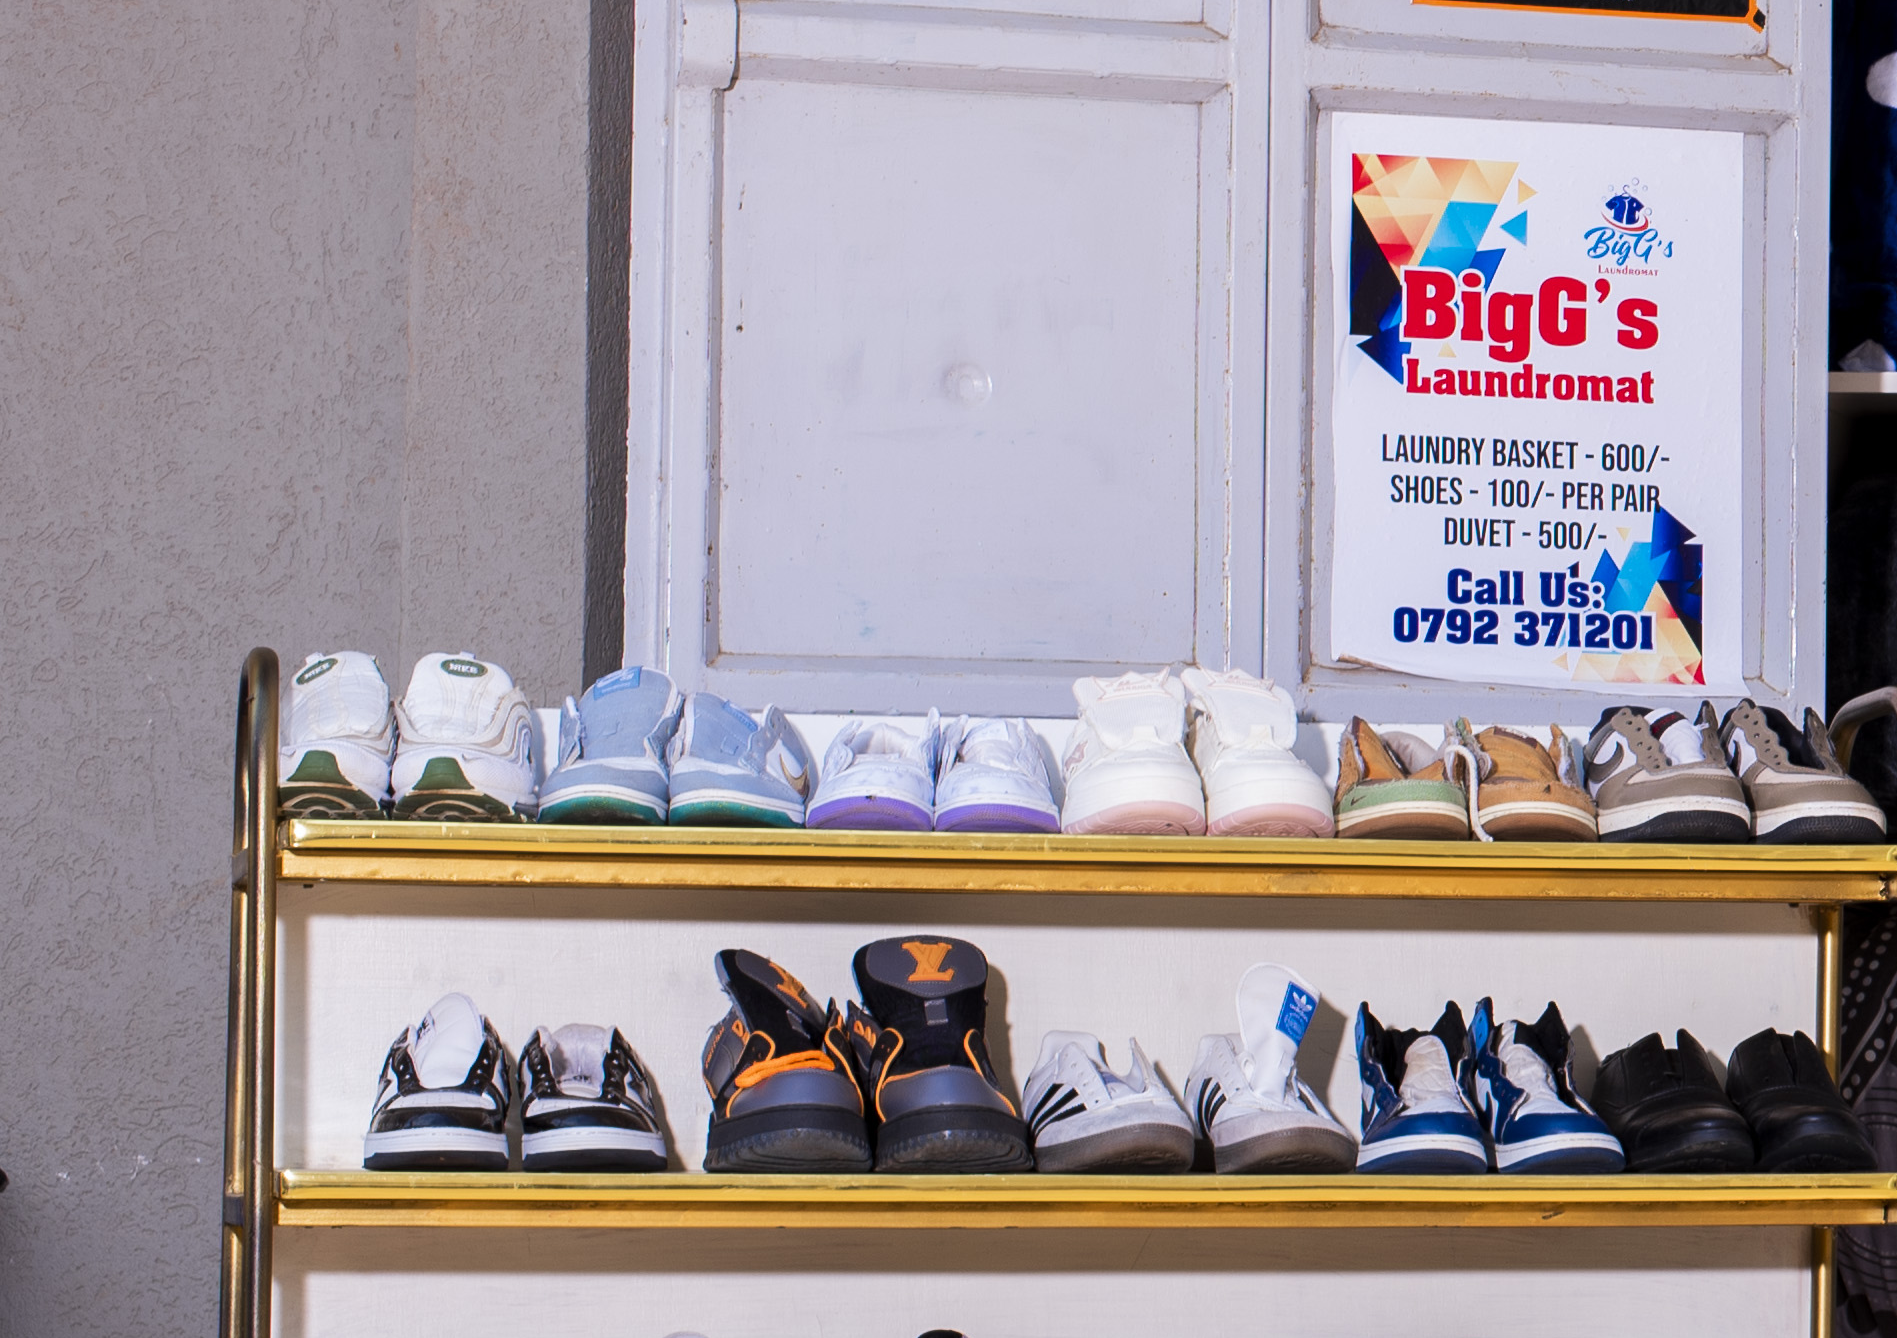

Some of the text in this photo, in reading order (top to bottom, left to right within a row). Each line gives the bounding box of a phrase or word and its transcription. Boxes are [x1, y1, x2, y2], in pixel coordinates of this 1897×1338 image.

[1584, 226, 1674, 266] BigG's
[1403, 269, 1660, 363] BigG's
[1404, 357, 1655, 405] Laundromat
[1381, 434, 1485, 465] LAUNDRY
[1492, 438, 1579, 470] BASKET
[1600, 442, 1671, 474] 600/-
[1389, 475, 1463, 506] SHOES
[1487, 478, 1556, 510] 100/-
[1562, 481, 1604, 512] PER
[1610, 483, 1662, 514] PAIR
[1443, 517, 1516, 549] DUVET
[1537, 520, 1608, 552] 500/-
[1447, 568, 1602, 610] Call Us:
[1392, 607, 1654, 650] 0792 371201
